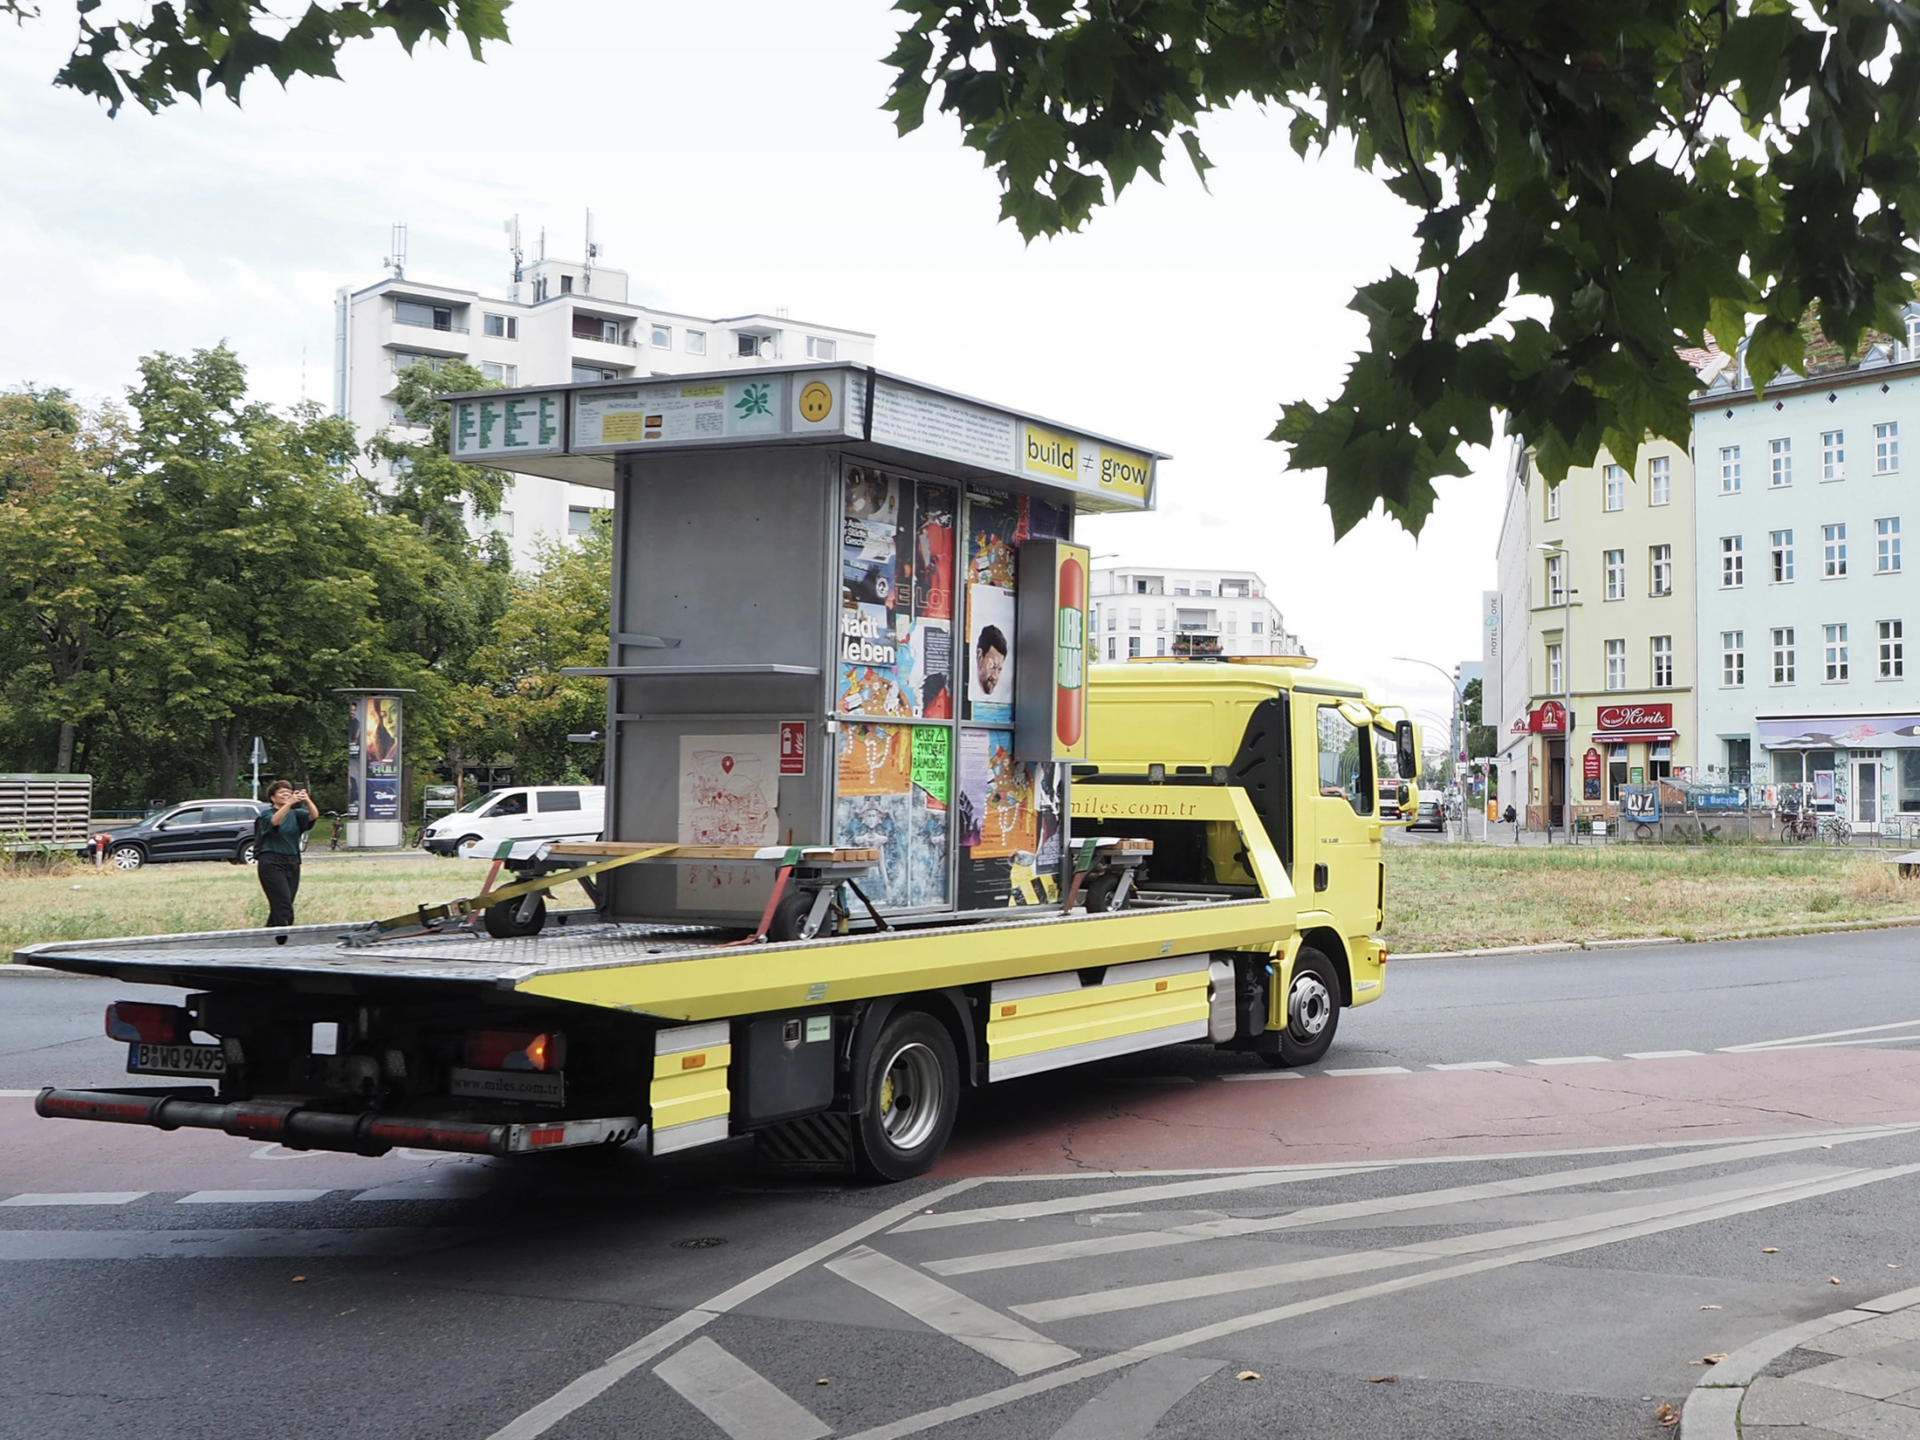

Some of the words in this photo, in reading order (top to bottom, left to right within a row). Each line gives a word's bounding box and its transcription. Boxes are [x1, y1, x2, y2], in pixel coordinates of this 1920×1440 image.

[1028, 434, 1074, 471] build
[1101, 458, 1147, 486] grow
[842, 614, 879, 639] tadt
[843, 637, 895, 663] leben
[1601, 707, 1665, 727] Moritz
[140, 1045, 149, 1066] B
[183, 1048, 225, 1071] 9495
[453, 1078, 559, 1095] www.miles.com.tr
